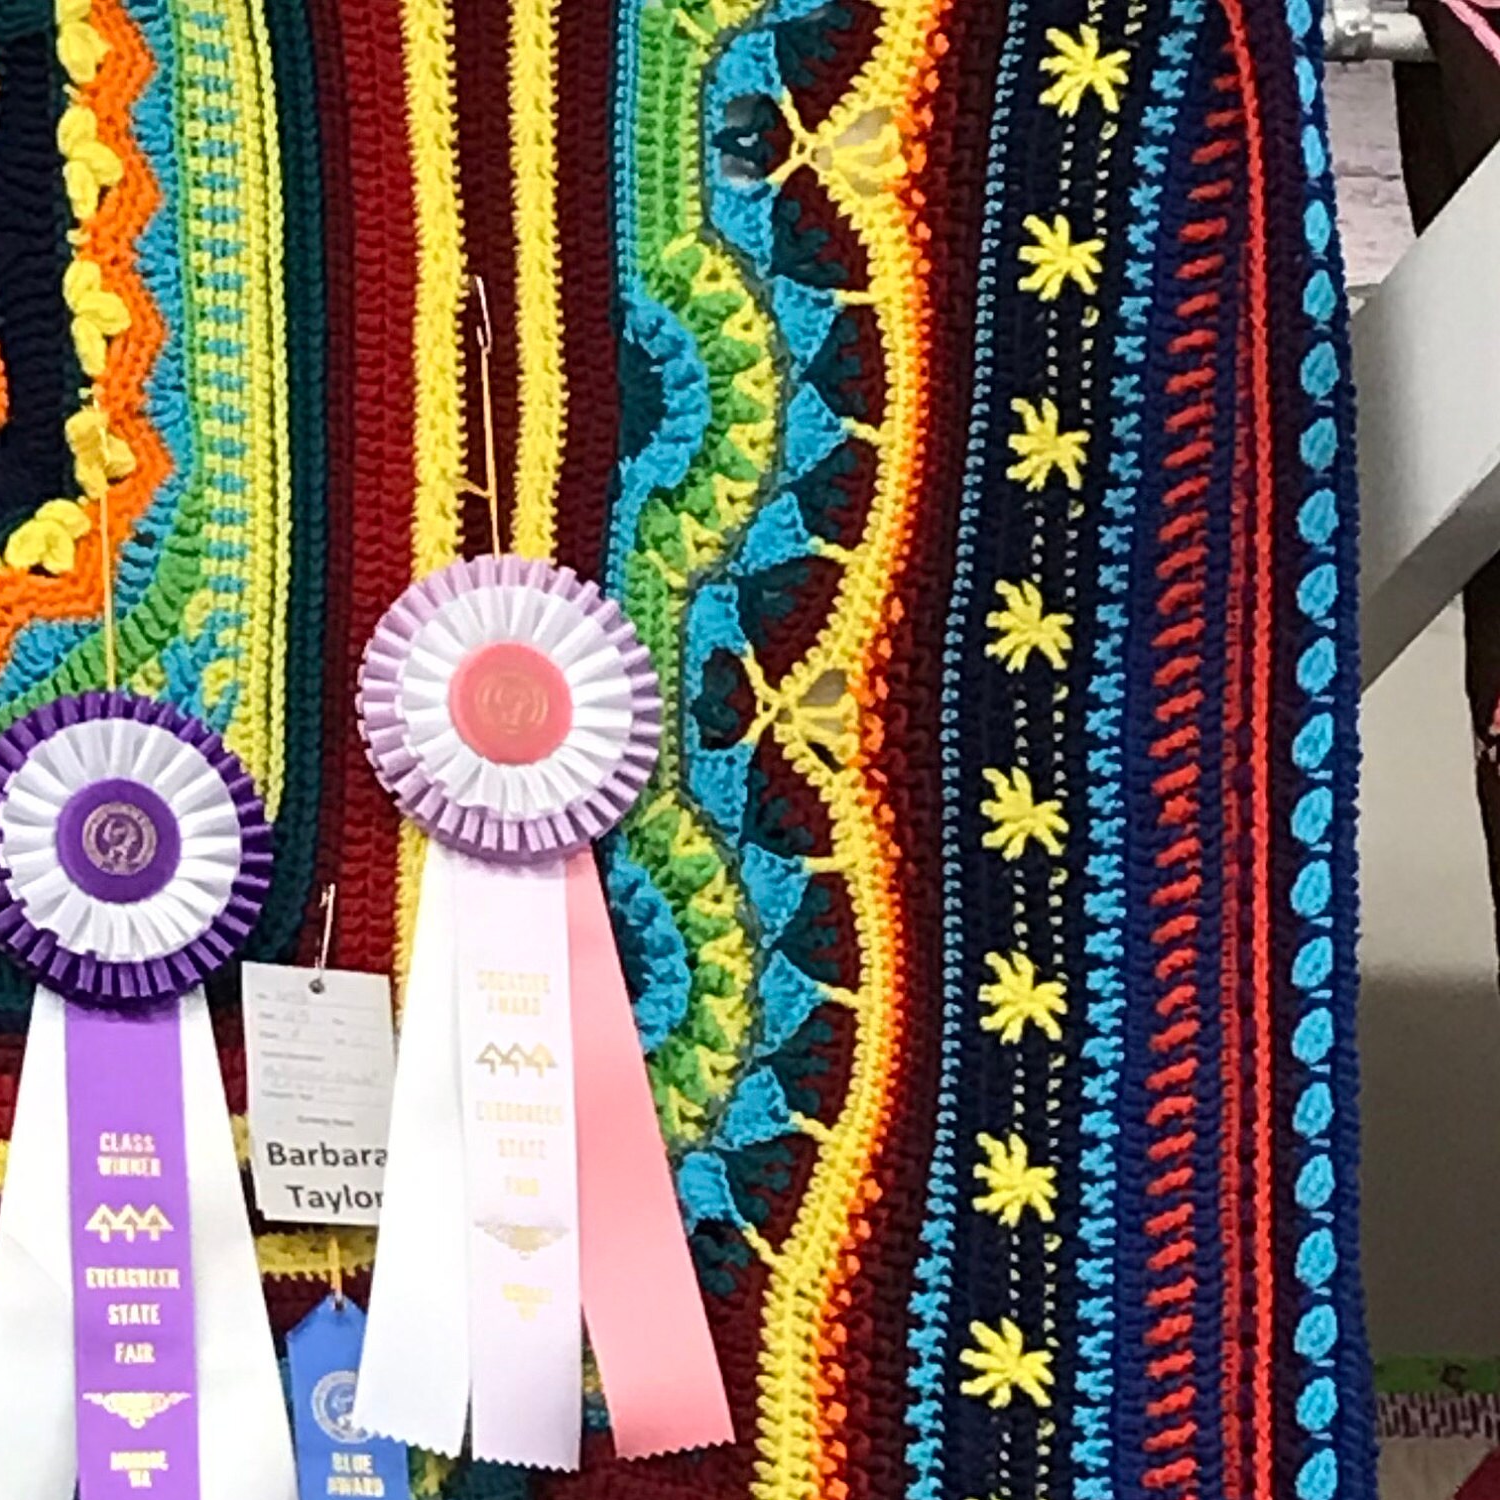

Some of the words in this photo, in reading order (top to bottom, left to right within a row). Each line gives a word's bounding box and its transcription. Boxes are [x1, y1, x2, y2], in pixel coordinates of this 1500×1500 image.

[99, 1131, 156, 1153] CLASS
[266, 1141, 388, 1167] Barbara
[97, 1155, 161, 1177] WINNER
[285, 1184, 383, 1214] Taylor
[85, 1267, 180, 1289] EVERGREEN
[107, 1303, 161, 1325] STATE
[114, 1342, 156, 1364] FAIR
[331, 1451, 373, 1474] BLUE
